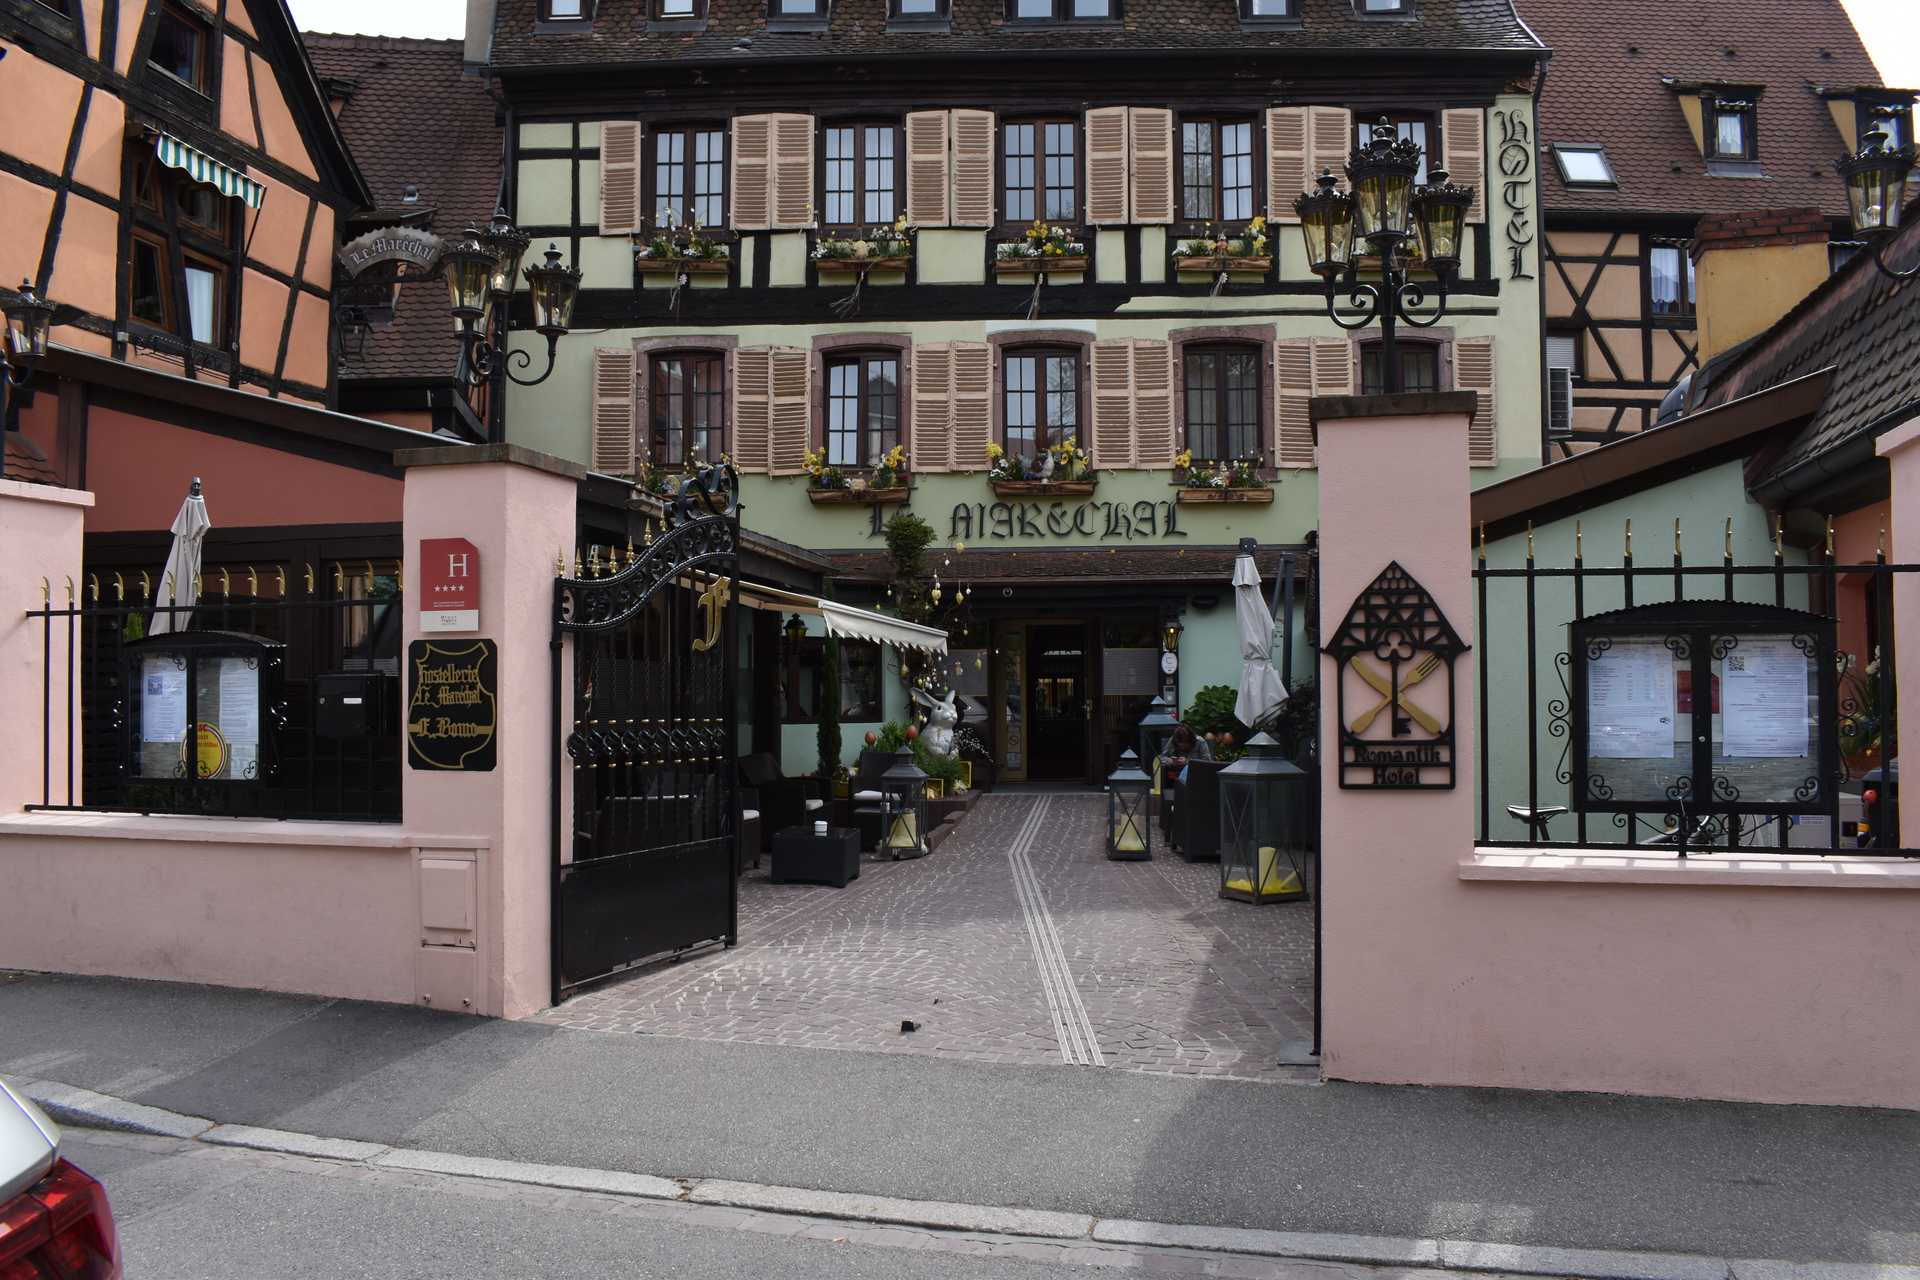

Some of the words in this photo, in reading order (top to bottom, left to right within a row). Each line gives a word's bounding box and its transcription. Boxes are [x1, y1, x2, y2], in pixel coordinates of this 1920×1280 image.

[1494, 110, 1535, 281] HOTEL
[350, 247, 369, 265] Le
[447, 553, 470, 578] H
[1353, 746, 1441, 763] Romantik
[1372, 767, 1420, 784] Hotel
